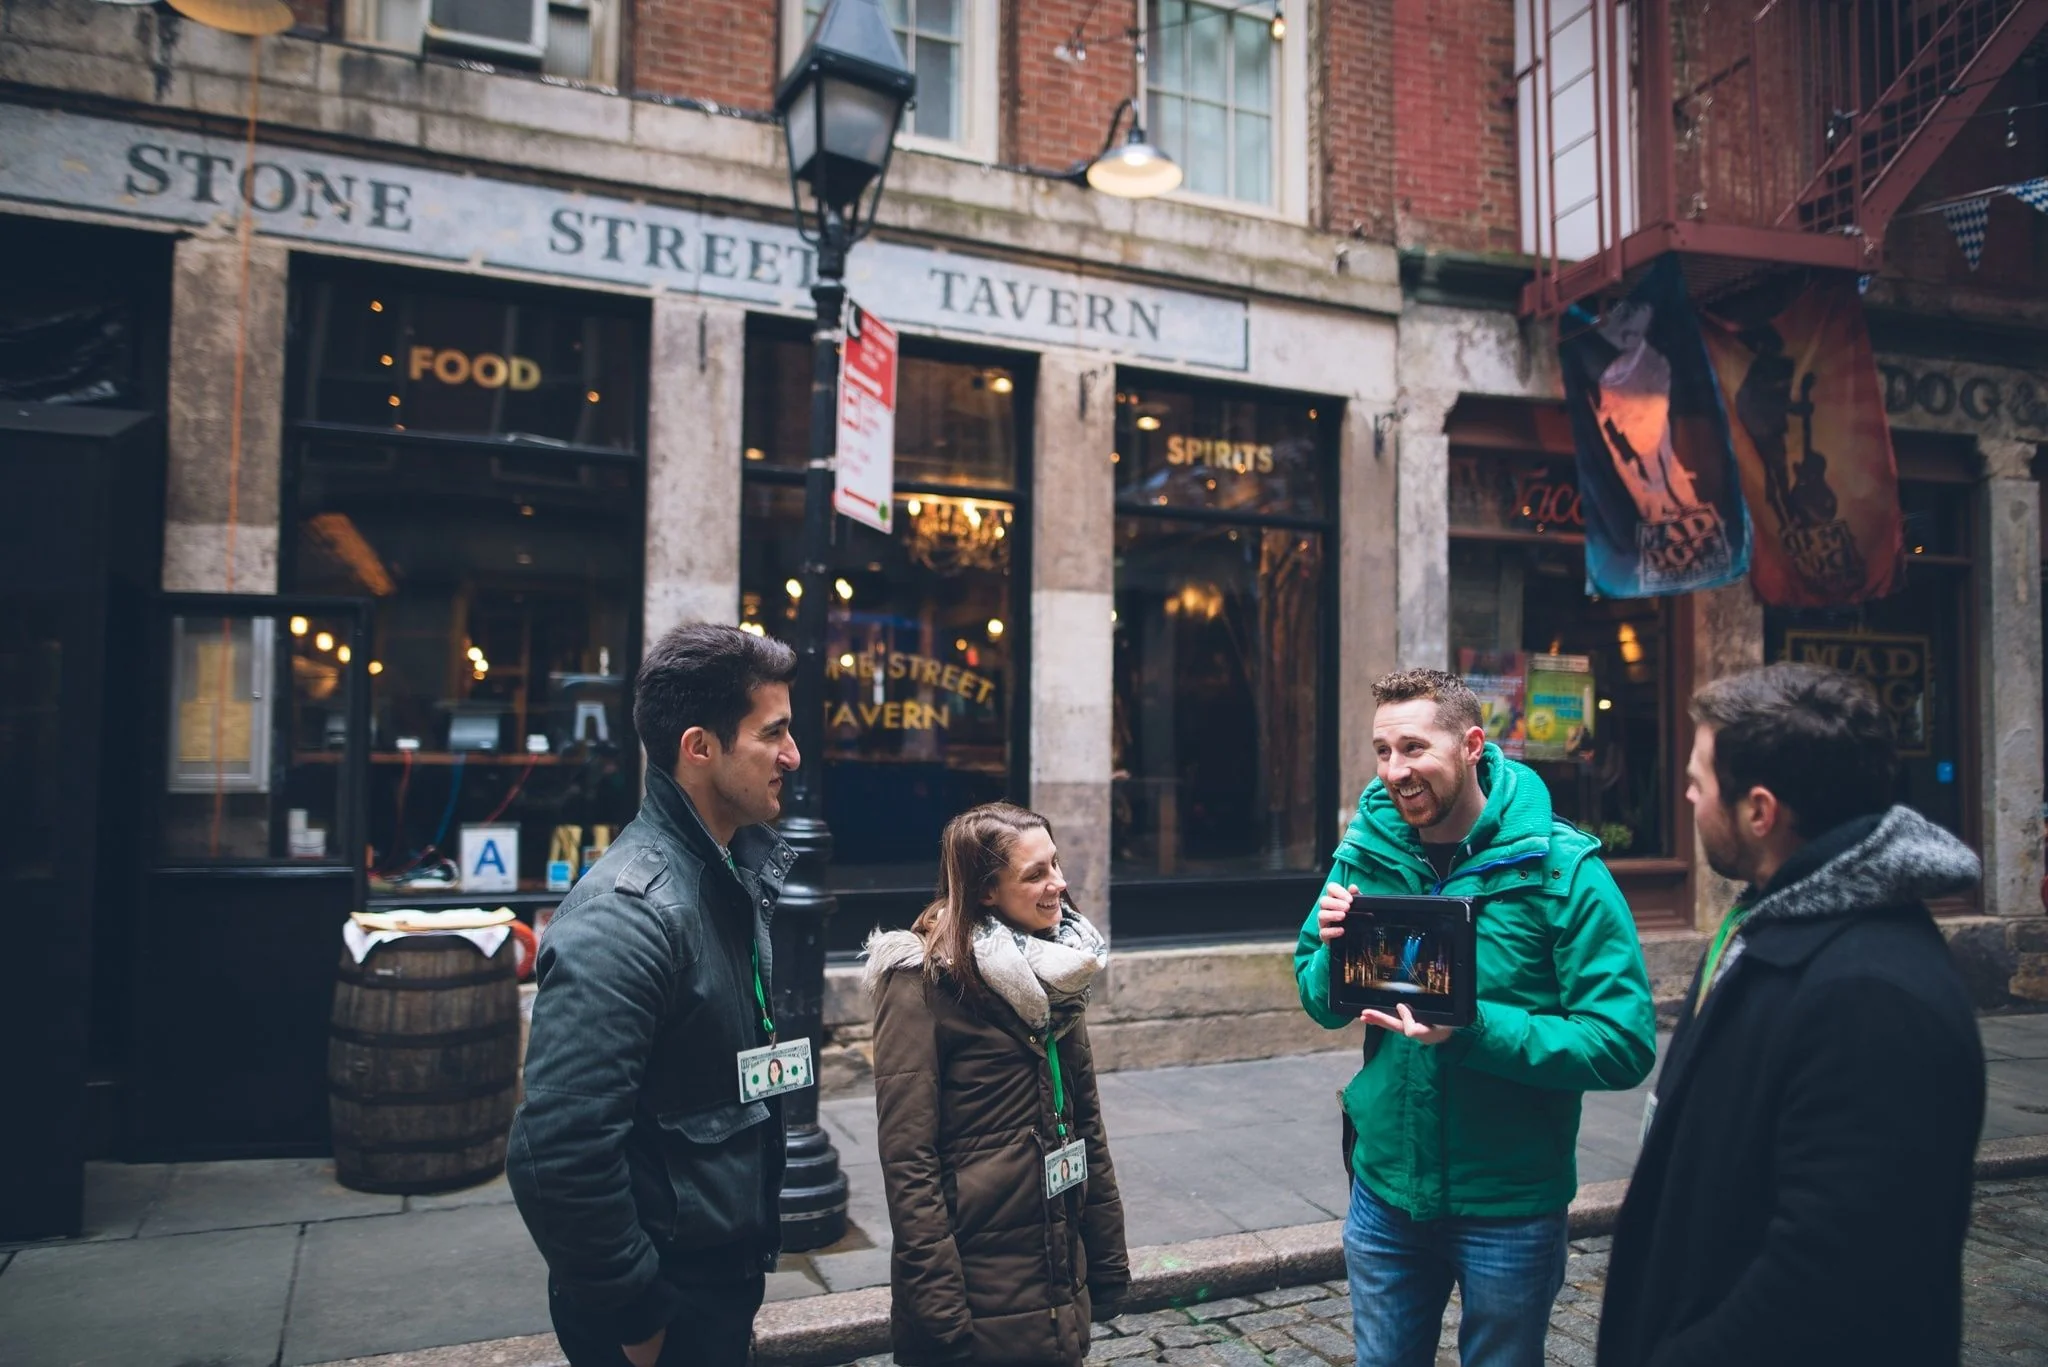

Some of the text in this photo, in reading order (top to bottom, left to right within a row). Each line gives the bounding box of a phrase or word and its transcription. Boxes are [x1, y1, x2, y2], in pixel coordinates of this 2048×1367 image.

[124, 142, 1164, 342] STONE STREET TAVERN
[408, 345, 542, 391] FOOD
[1879, 364, 2001, 422] DOG
[1166, 434, 1274, 474] SPIRITS
[888, 651, 996, 705] STREET
[1802, 643, 1919, 678] MAD
[473, 838, 506, 876] A
